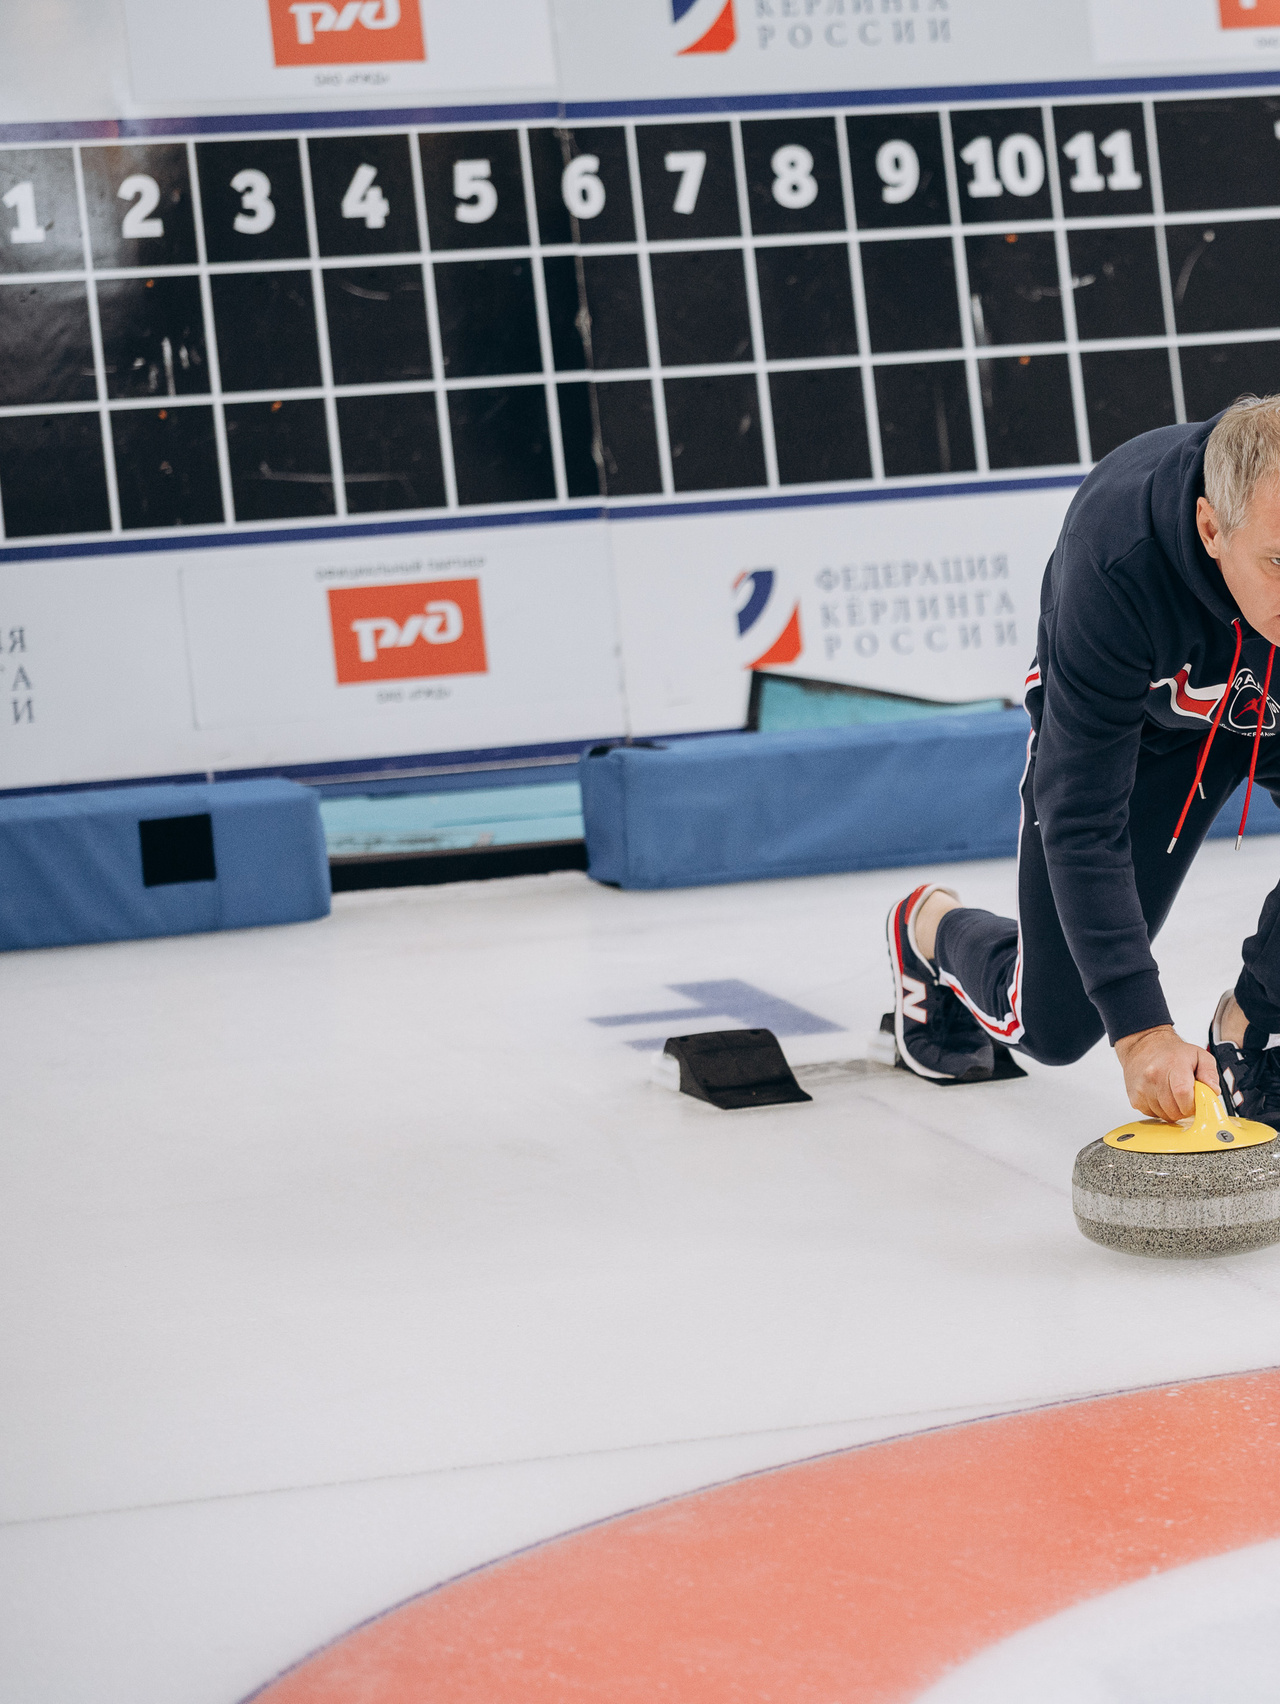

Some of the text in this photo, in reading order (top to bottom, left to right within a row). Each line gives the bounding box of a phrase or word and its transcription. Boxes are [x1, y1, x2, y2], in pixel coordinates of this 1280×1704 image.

[758, 18, 952, 49] РОССИИ
[1, 181, 45, 244] 1
[117, 173, 163, 239] 2
[230, 169, 276, 235] 3
[341, 164, 390, 229] 4
[453, 159, 498, 224] 5
[562, 154, 606, 220] 6
[664, 151, 707, 215] 7
[771, 144, 818, 209] 8
[876, 140, 920, 204] 9
[960, 133, 1045, 198] 10
[1063, 130, 1142, 193] 11
[815, 552, 1009, 594] ФЕДЕРАЦИЯ
[823, 619, 1019, 661] РОССИИ
